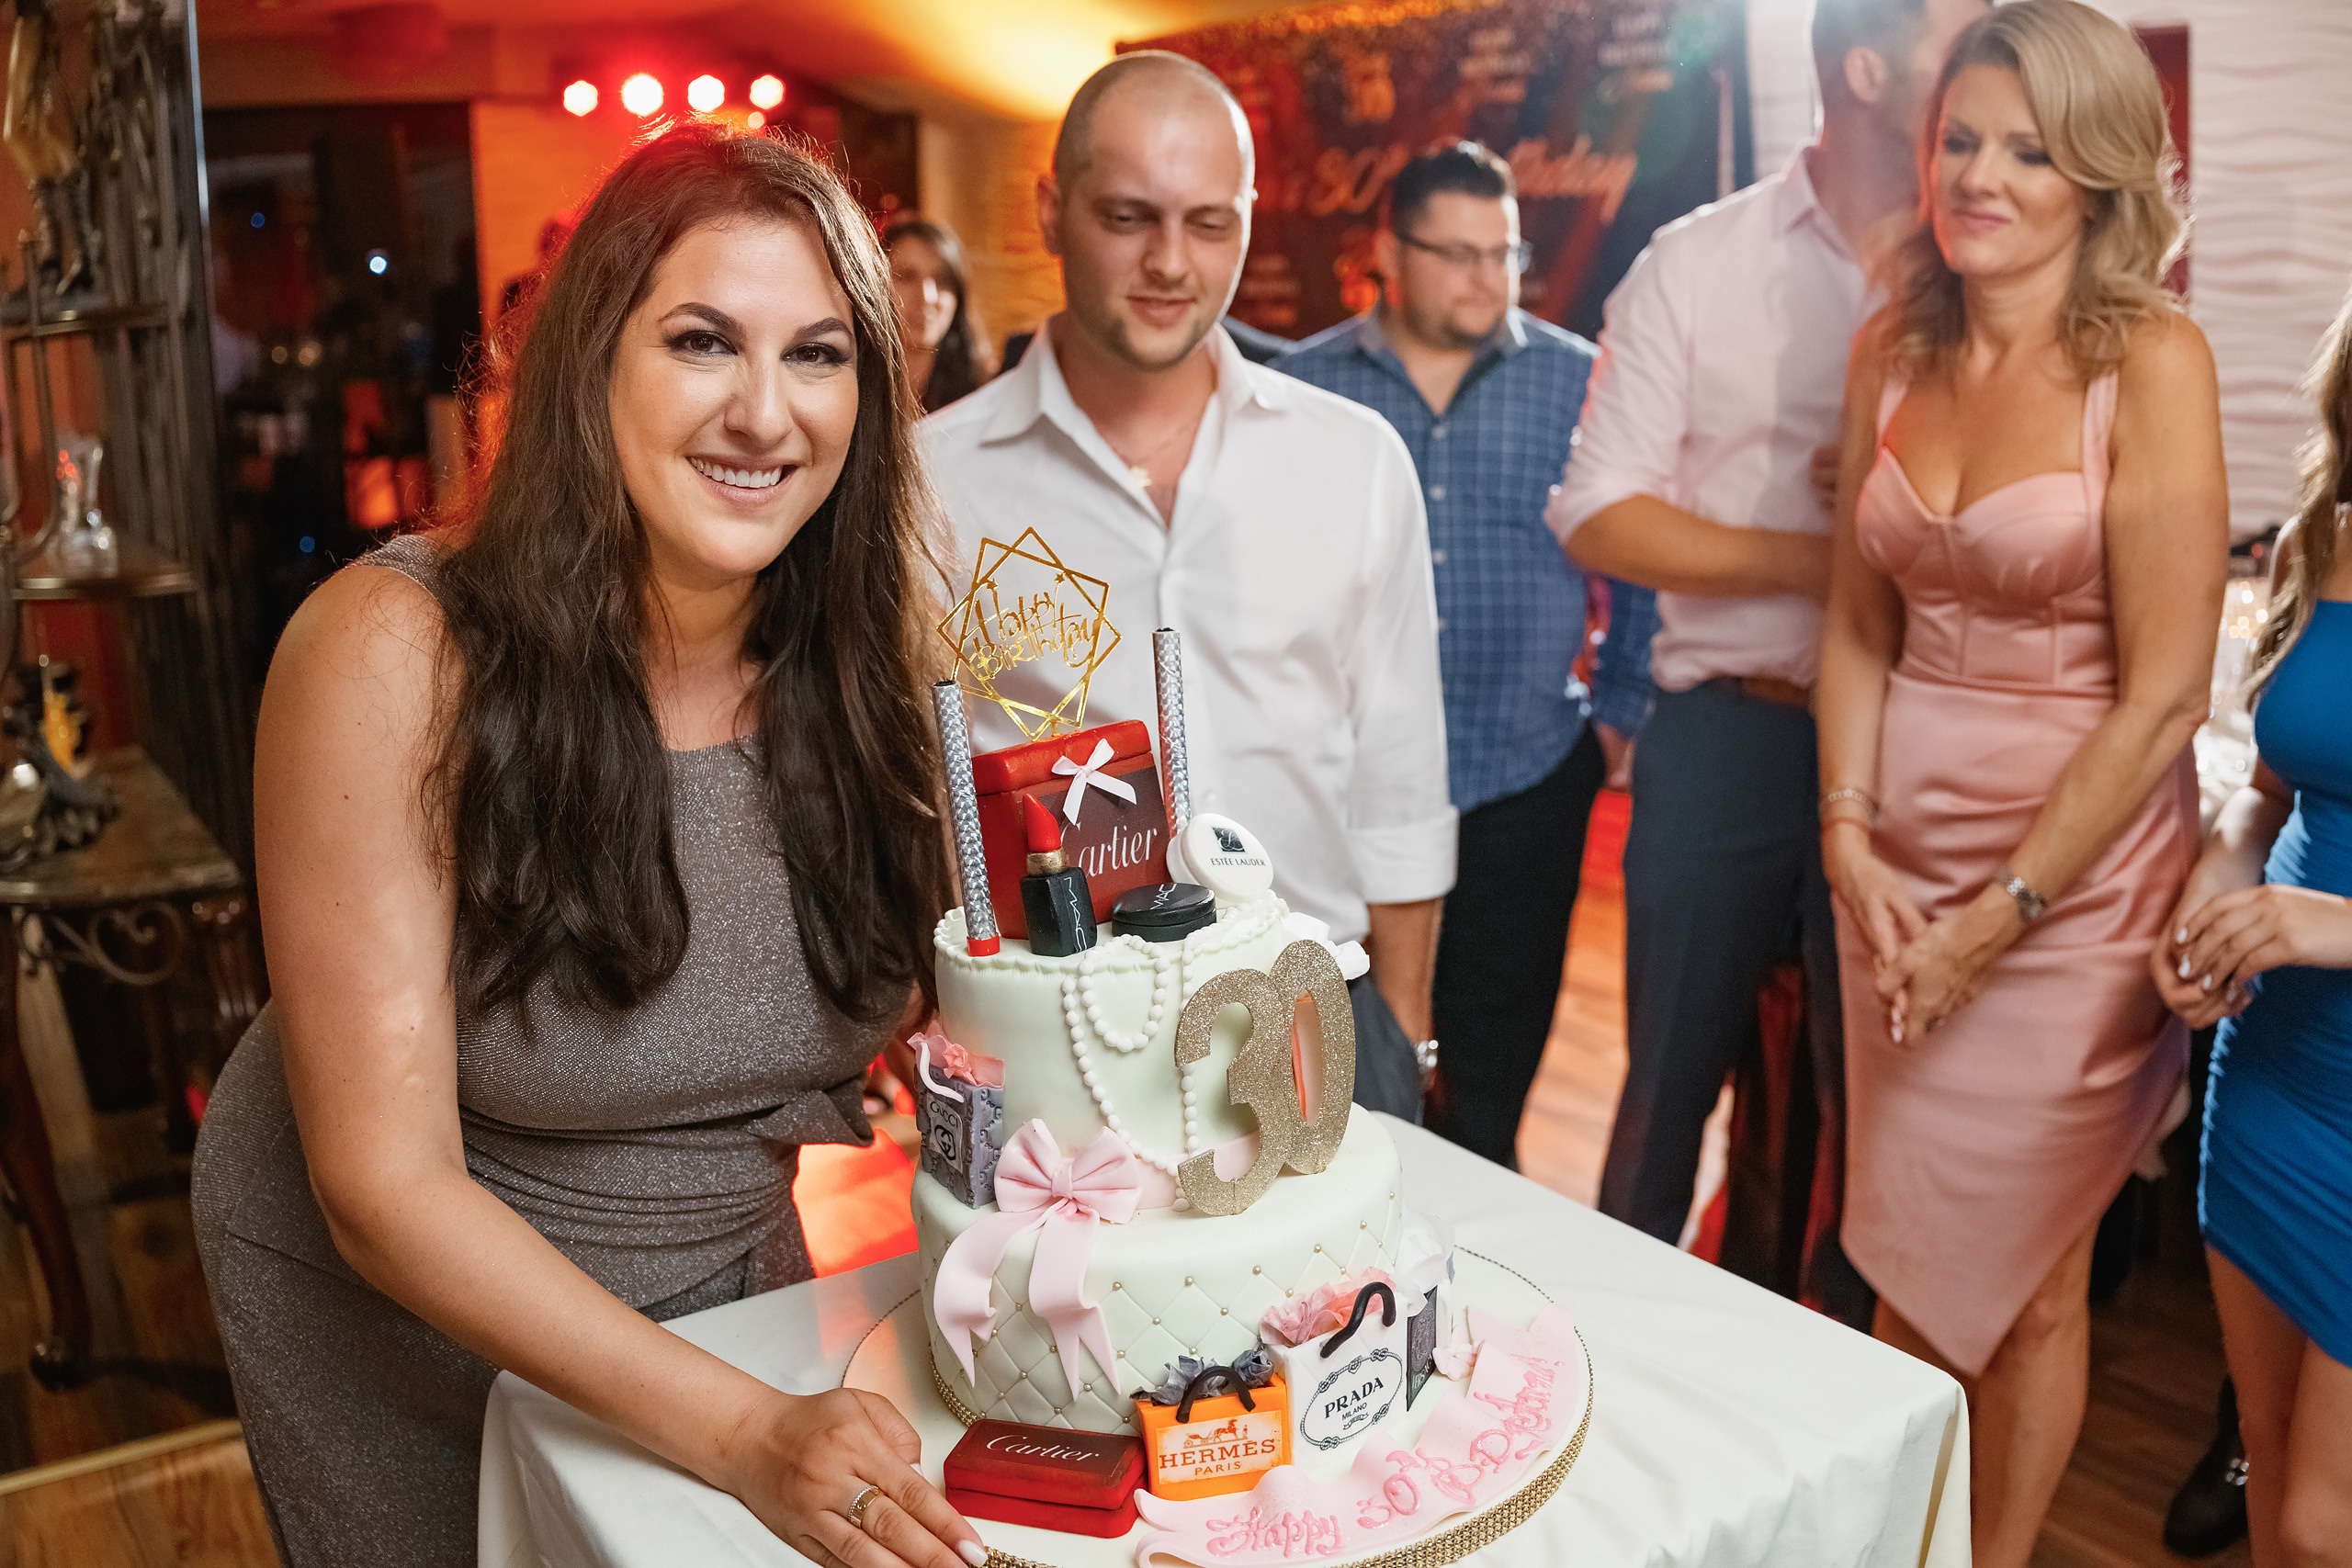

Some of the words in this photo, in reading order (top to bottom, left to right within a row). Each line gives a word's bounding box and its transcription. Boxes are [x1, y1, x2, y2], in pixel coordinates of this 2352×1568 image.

[965, 579, 1063, 646] Happy
[1235, 858, 1266, 866] LAUDER
[1174, 939, 1356, 1215] 30
[930, 1100, 958, 1129] GUCCI
[1324, 1377, 1385, 1419] PRADA
[1341, 1403, 1368, 1421] MILANO
[986, 1435, 1100, 1461] Cartier
[1194, 1461, 1241, 1476] PARIS
[1206, 1506, 1345, 1559] Happy
